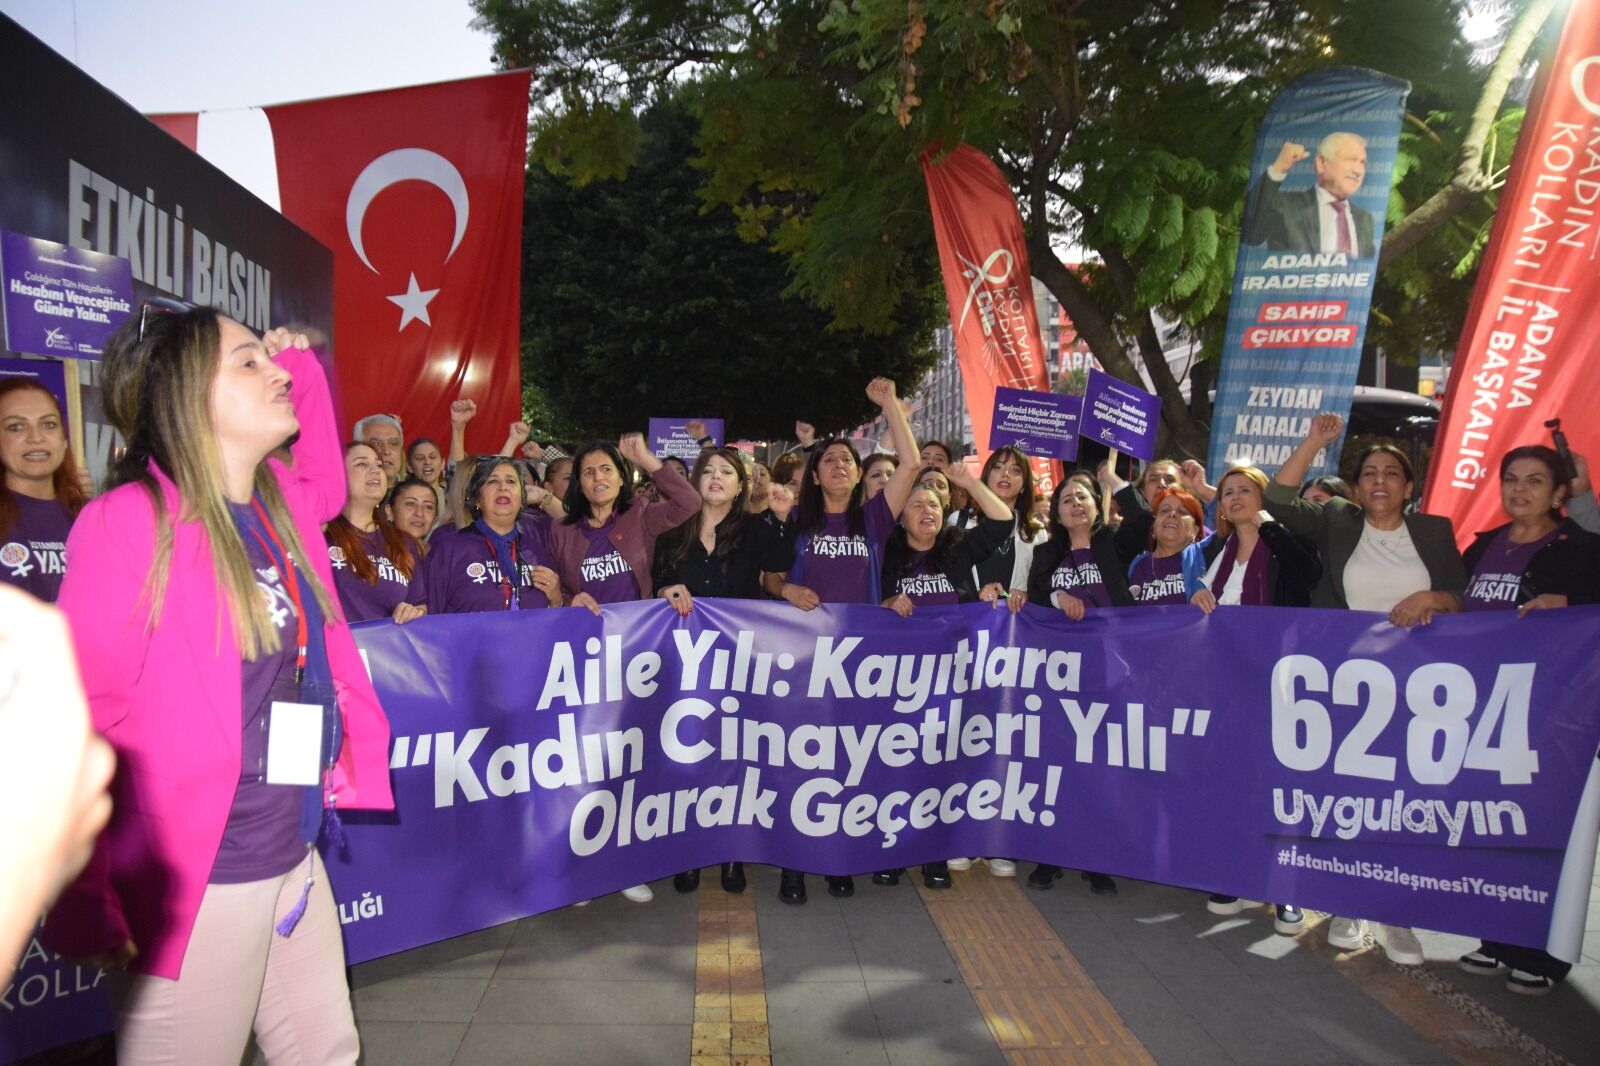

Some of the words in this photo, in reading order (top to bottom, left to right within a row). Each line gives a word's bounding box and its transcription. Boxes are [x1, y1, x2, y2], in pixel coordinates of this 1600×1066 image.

[1514, 121, 1584, 270] KOLLARI
[69, 158, 185, 298] ETKİLİ
[192, 228, 270, 331] BASIN
[1261, 252, 1349, 270] ADANA
[10, 279, 64, 301] Hesabını
[65, 289, 130, 313] Vereceğiniz
[61, 278, 77, 290] Tüm
[34, 299, 75, 318] Günler
[75, 305, 111, 324] Yakın.
[1264, 304, 1342, 322] SAHİP
[1496, 295, 1537, 322] İL
[1250, 327, 1351, 348] ÇIKIYOR
[1506, 301, 1559, 408] ADANA
[1247, 386, 1323, 410] ZEYDAN
[1451, 334, 1516, 490] BAŞKALIĞI
[1050, 410, 1077, 420] Zaman
[1235, 414, 1313, 438] KARALA
[536, 635, 662, 711] Aile
[673, 629, 795, 698] Yılı:
[807, 629, 1082, 713] Kayıtlara
[1271, 654, 1540, 785] 6284
[659, 694, 1042, 787] Cinayetleri
[569, 768, 778, 857] Olarak
[790, 761, 1063, 848] Geçecek!
[1277, 846, 1549, 904] #İstanbulSözleşmesiYaşatır
[339, 892, 384, 925] LIĞI
